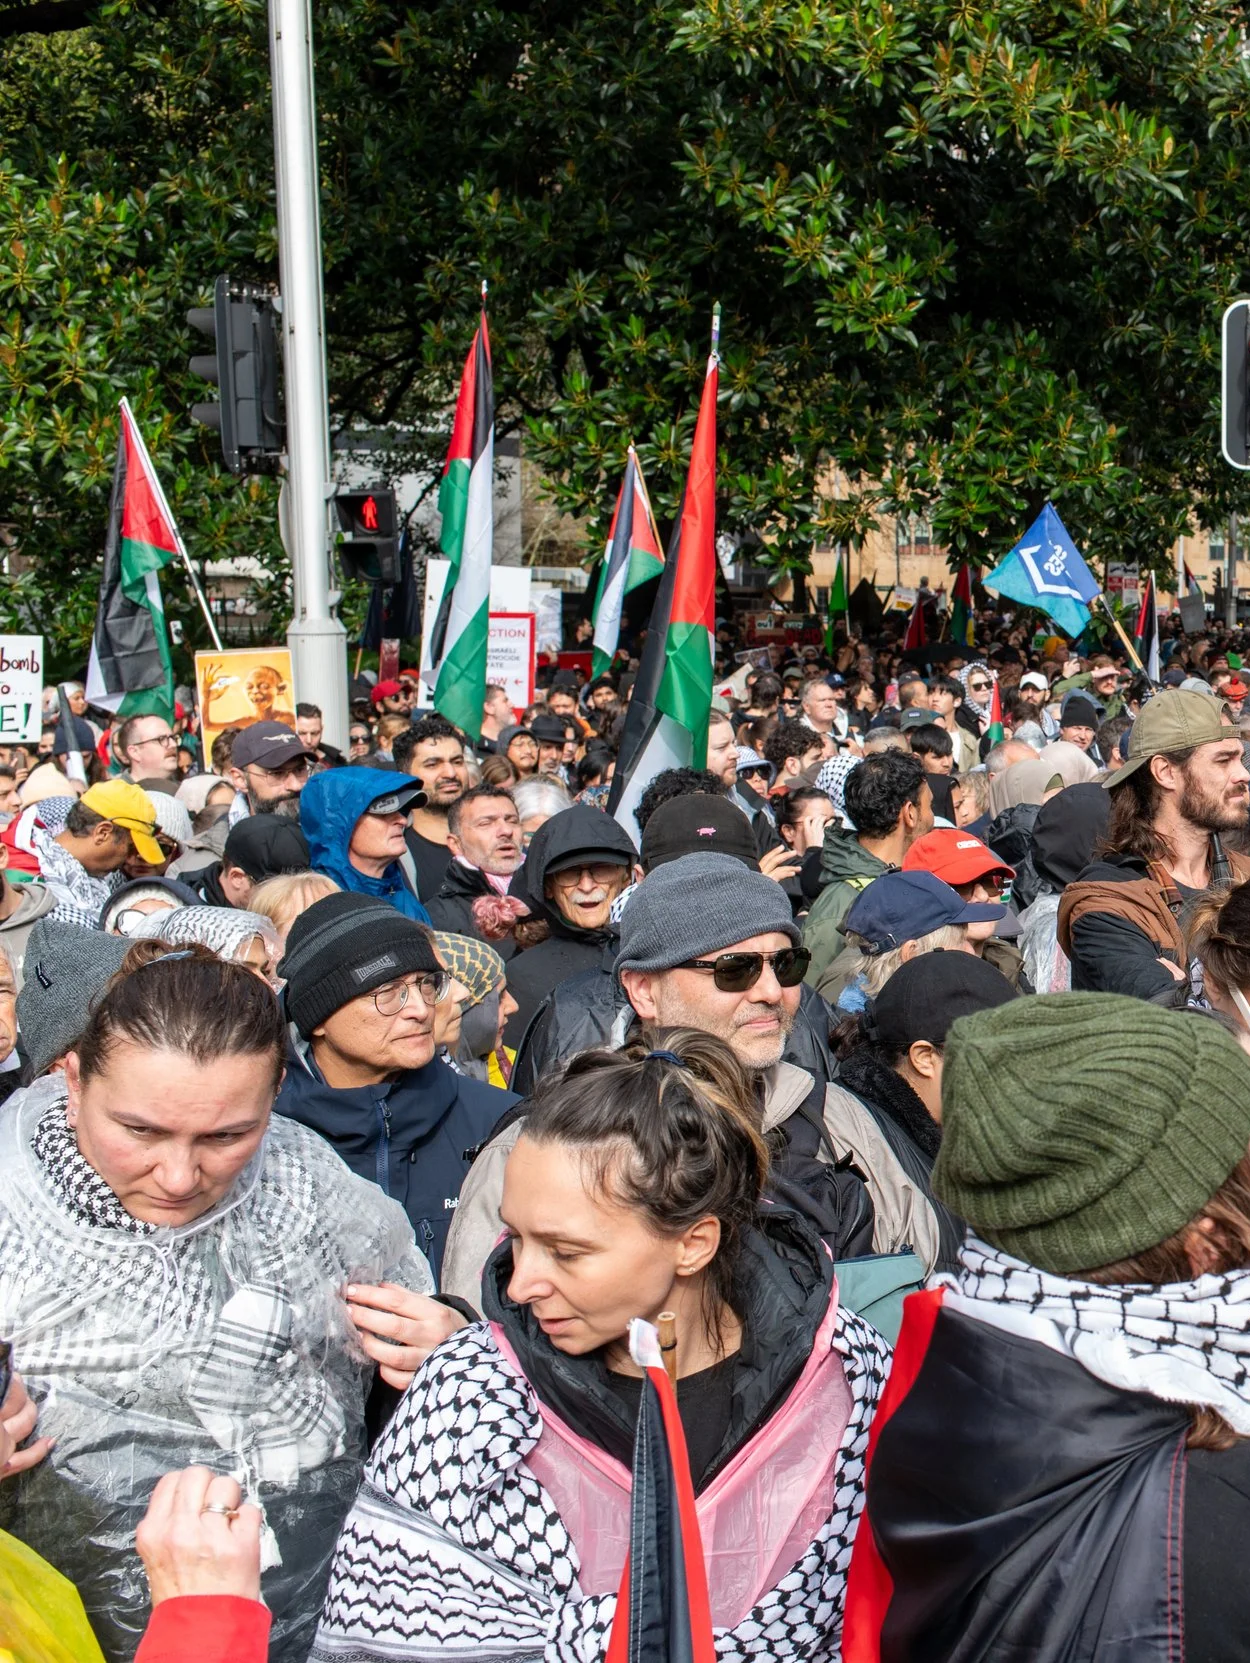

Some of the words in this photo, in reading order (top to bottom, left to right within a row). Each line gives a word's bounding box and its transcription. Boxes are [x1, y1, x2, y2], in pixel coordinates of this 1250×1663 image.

[488, 629, 526, 638] CTION
[0, 647, 40, 673] bomb
[487, 676, 508, 685] OW
